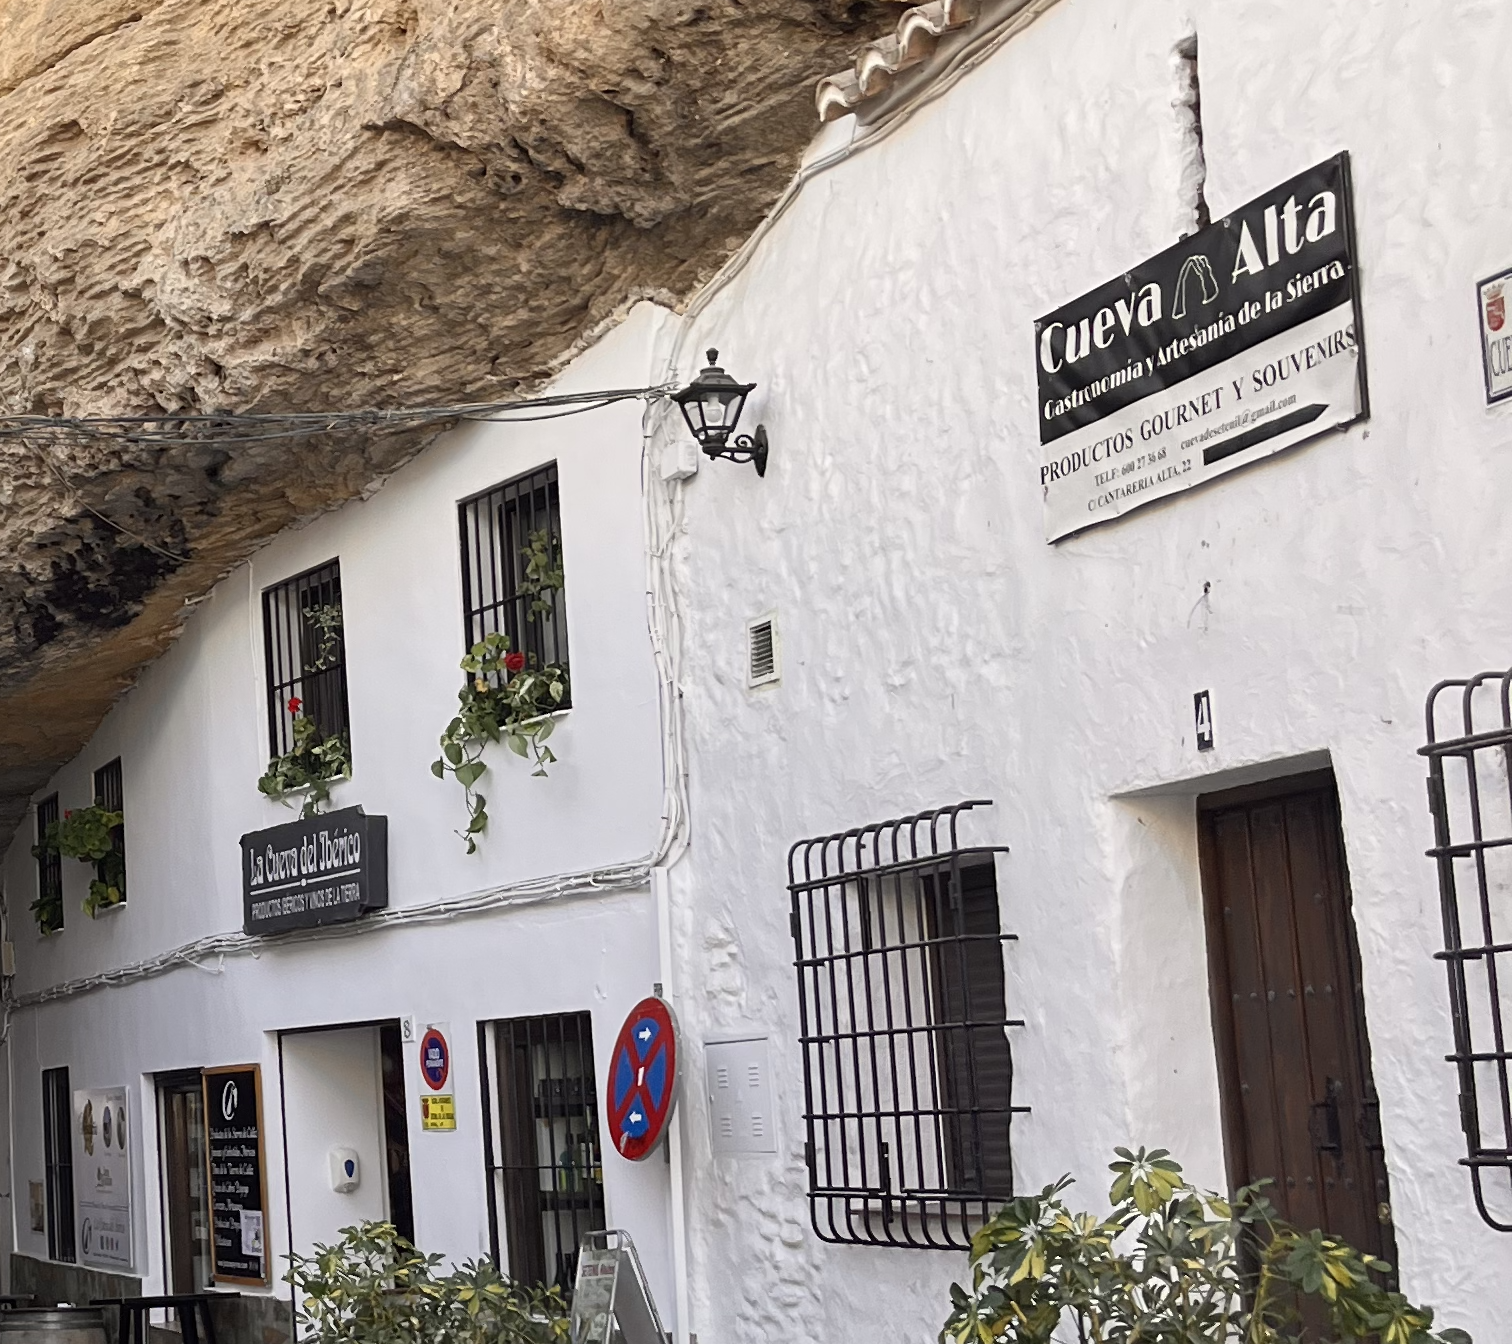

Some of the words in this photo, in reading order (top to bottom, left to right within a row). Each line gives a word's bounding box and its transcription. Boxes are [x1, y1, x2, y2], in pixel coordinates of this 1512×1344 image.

[1039, 282, 1163, 374] Cueva
[1231, 191, 1336, 285] Alta
[1145, 354, 1155, 377] y
[1238, 301, 1261, 326] de
[1265, 291, 1283, 313] la
[1286, 260, 1345, 303] Sierra
[1040, 427, 1134, 486] PRODUCTOS
[1232, 376, 1244, 401] Y
[1252, 323, 1357, 393] SOUVENIRS
[1197, 696, 1211, 741] 4
[249, 848, 264, 886] La
[265, 844, 298, 883] Cueva
[300, 833, 318, 875] del
[319, 827, 361, 871] Ibérico
[403, 1019, 412, 1038] 8
